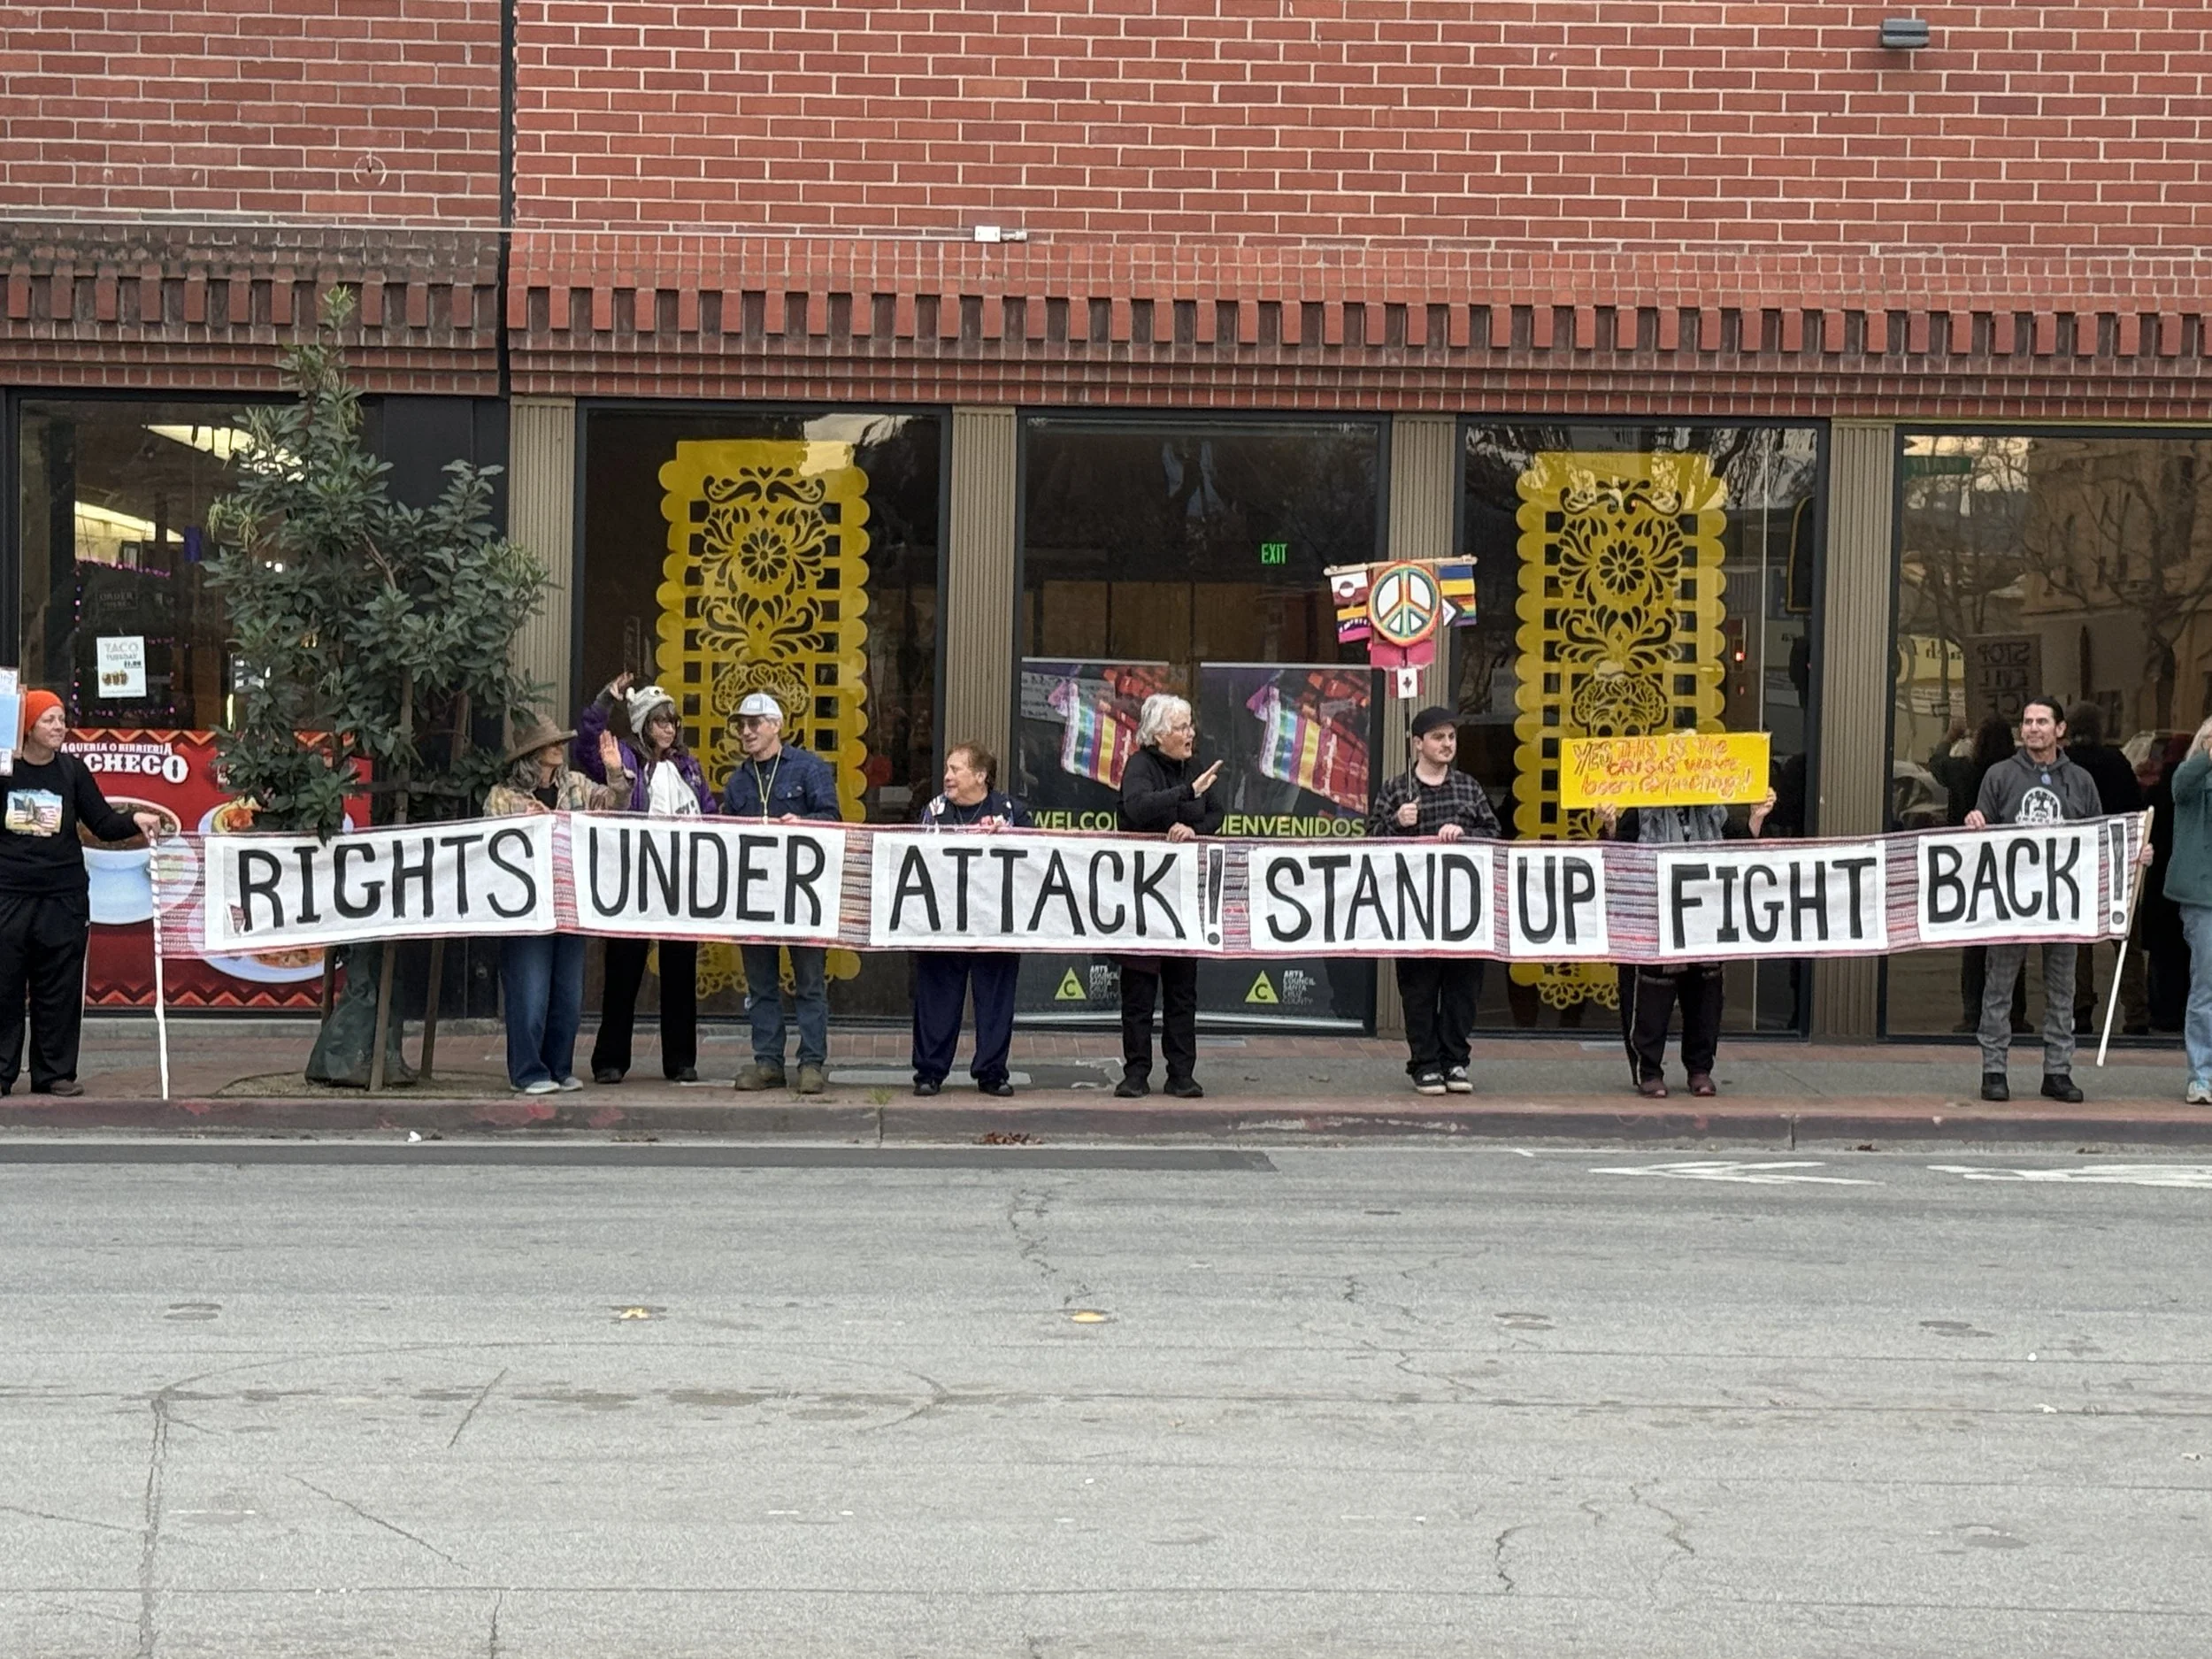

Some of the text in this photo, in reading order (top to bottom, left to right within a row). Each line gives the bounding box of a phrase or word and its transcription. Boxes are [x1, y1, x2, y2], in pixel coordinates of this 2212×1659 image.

[1261, 543, 1287, 565] EXIT
[104, 642, 139, 653] TACO
[60, 742, 107, 753] AQUERIA
[1616, 738, 1657, 759] THIS
[1669, 736, 1686, 759] IS
[76, 753, 188, 784] CHECO
[1028, 810, 1118, 831] WELCO
[1216, 814, 1366, 837] IENVENIDOS
[238, 828, 537, 933] RIGHTS
[589, 826, 826, 926] UNDER
[1265, 853, 1481, 943] STAND
[1517, 856, 1596, 946] UP
[1671, 856, 1878, 949] FIGHT
[1064, 979, 1077, 997] C
[1255, 983, 1268, 1000] C
[1283, 976, 1316, 986] COUNCIL
